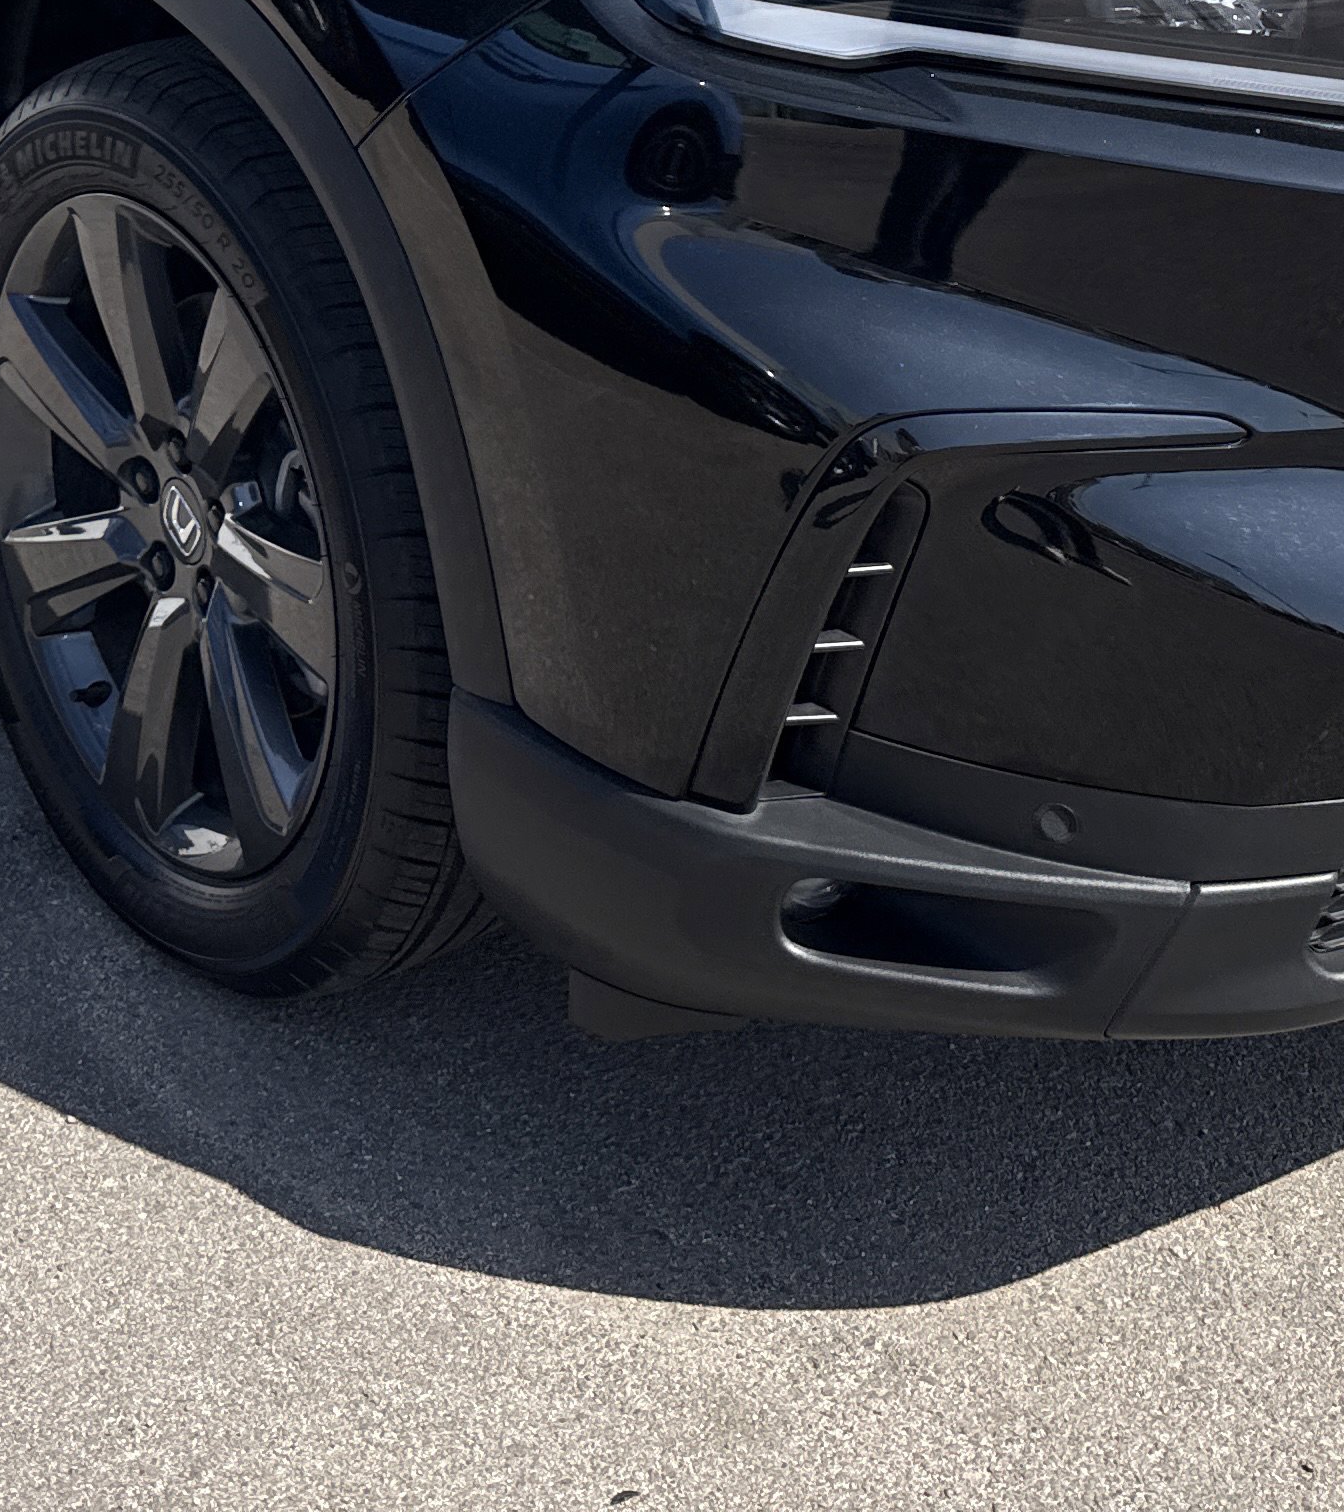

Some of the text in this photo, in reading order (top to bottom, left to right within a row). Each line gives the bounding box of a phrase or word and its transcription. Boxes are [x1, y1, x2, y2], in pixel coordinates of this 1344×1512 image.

[15, 130, 134, 176] MICHELIN
[152, 164, 256, 290] 255/50 R 20
